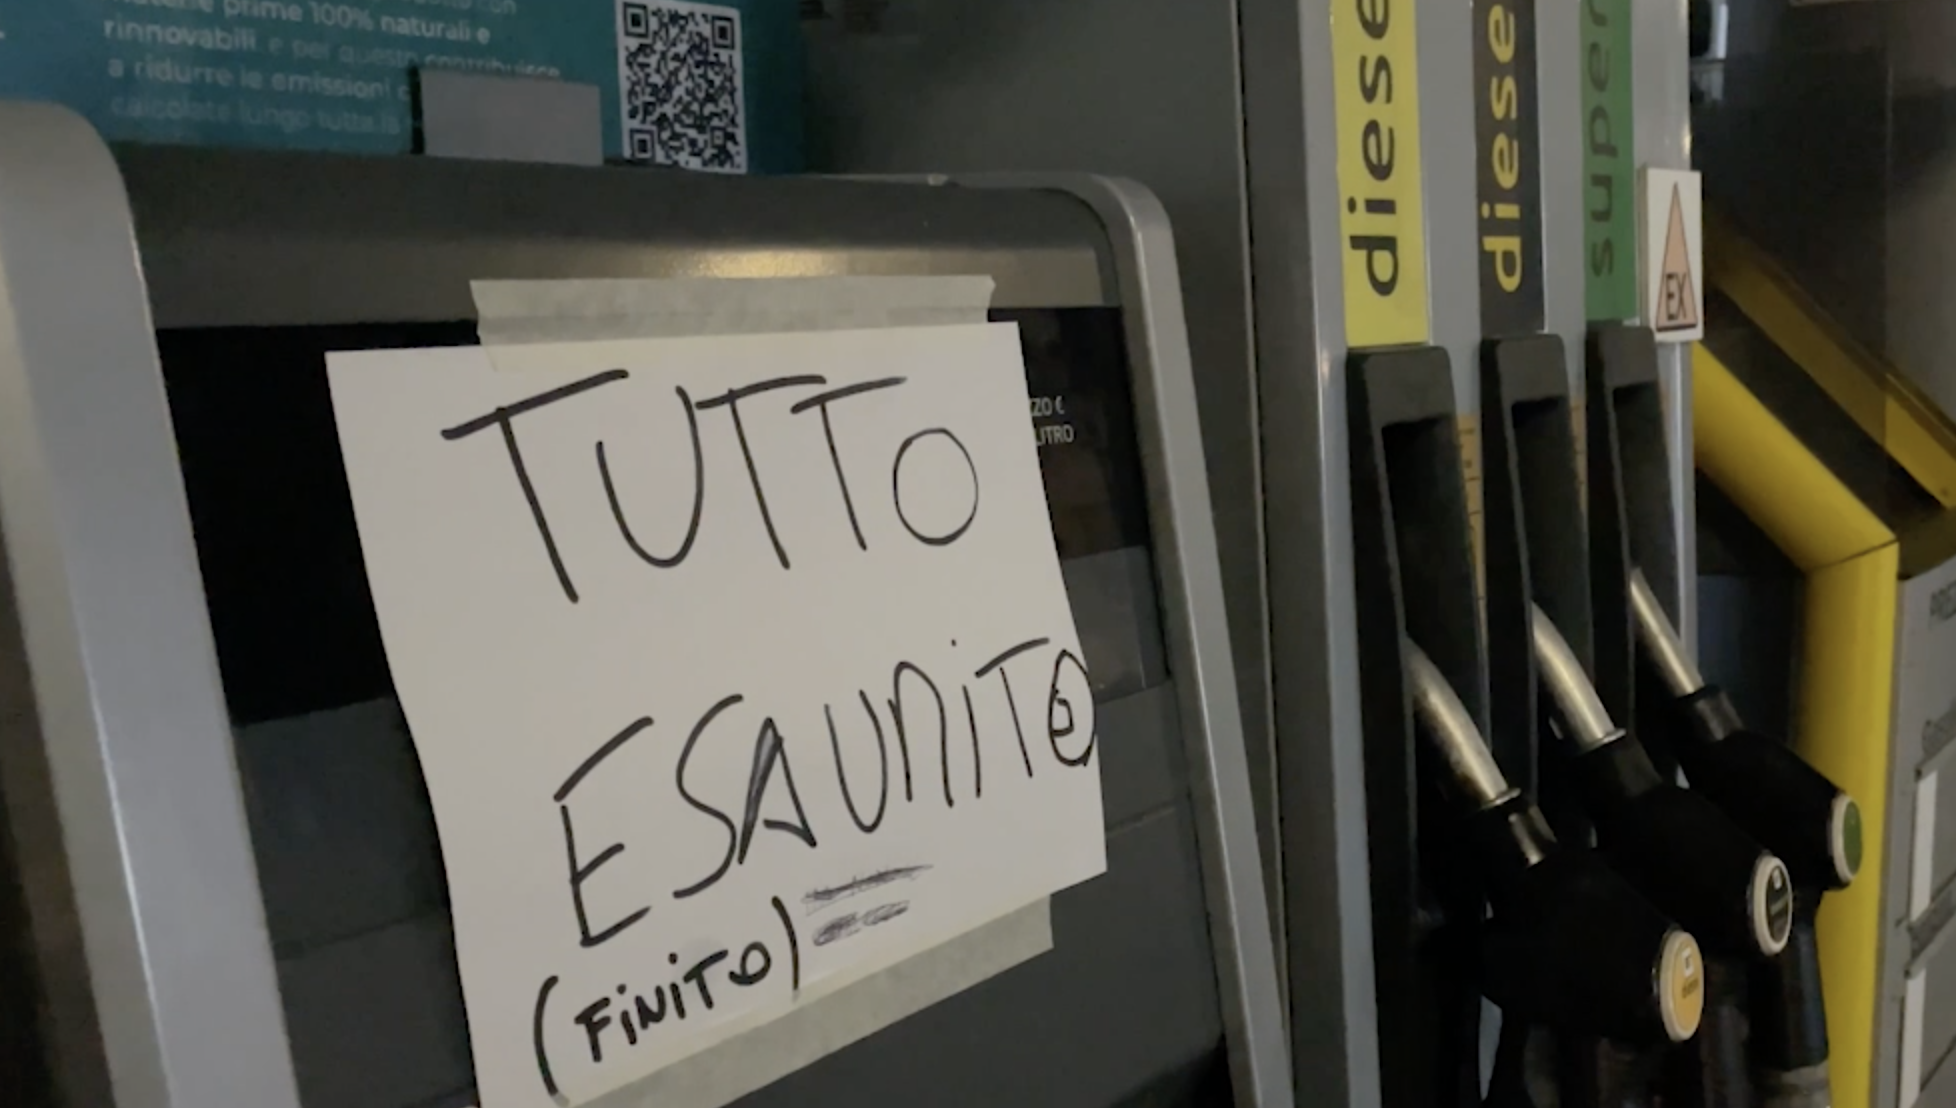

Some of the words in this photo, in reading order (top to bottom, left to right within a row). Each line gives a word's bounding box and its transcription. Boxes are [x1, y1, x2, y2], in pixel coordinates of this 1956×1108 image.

[103, 14, 257, 52] rinnovabili
[223, 0, 303, 22] prime
[311, 1, 375, 31] 100%
[380, 14, 471, 42] naturali
[476, 26, 491, 45] e
[107, 58, 125, 78] a
[133, 53, 234, 88] ridurre
[270, 71, 391, 100] emissioni
[1665, 272, 1687, 321] EX
[441, 369, 979, 604] TUTTO
